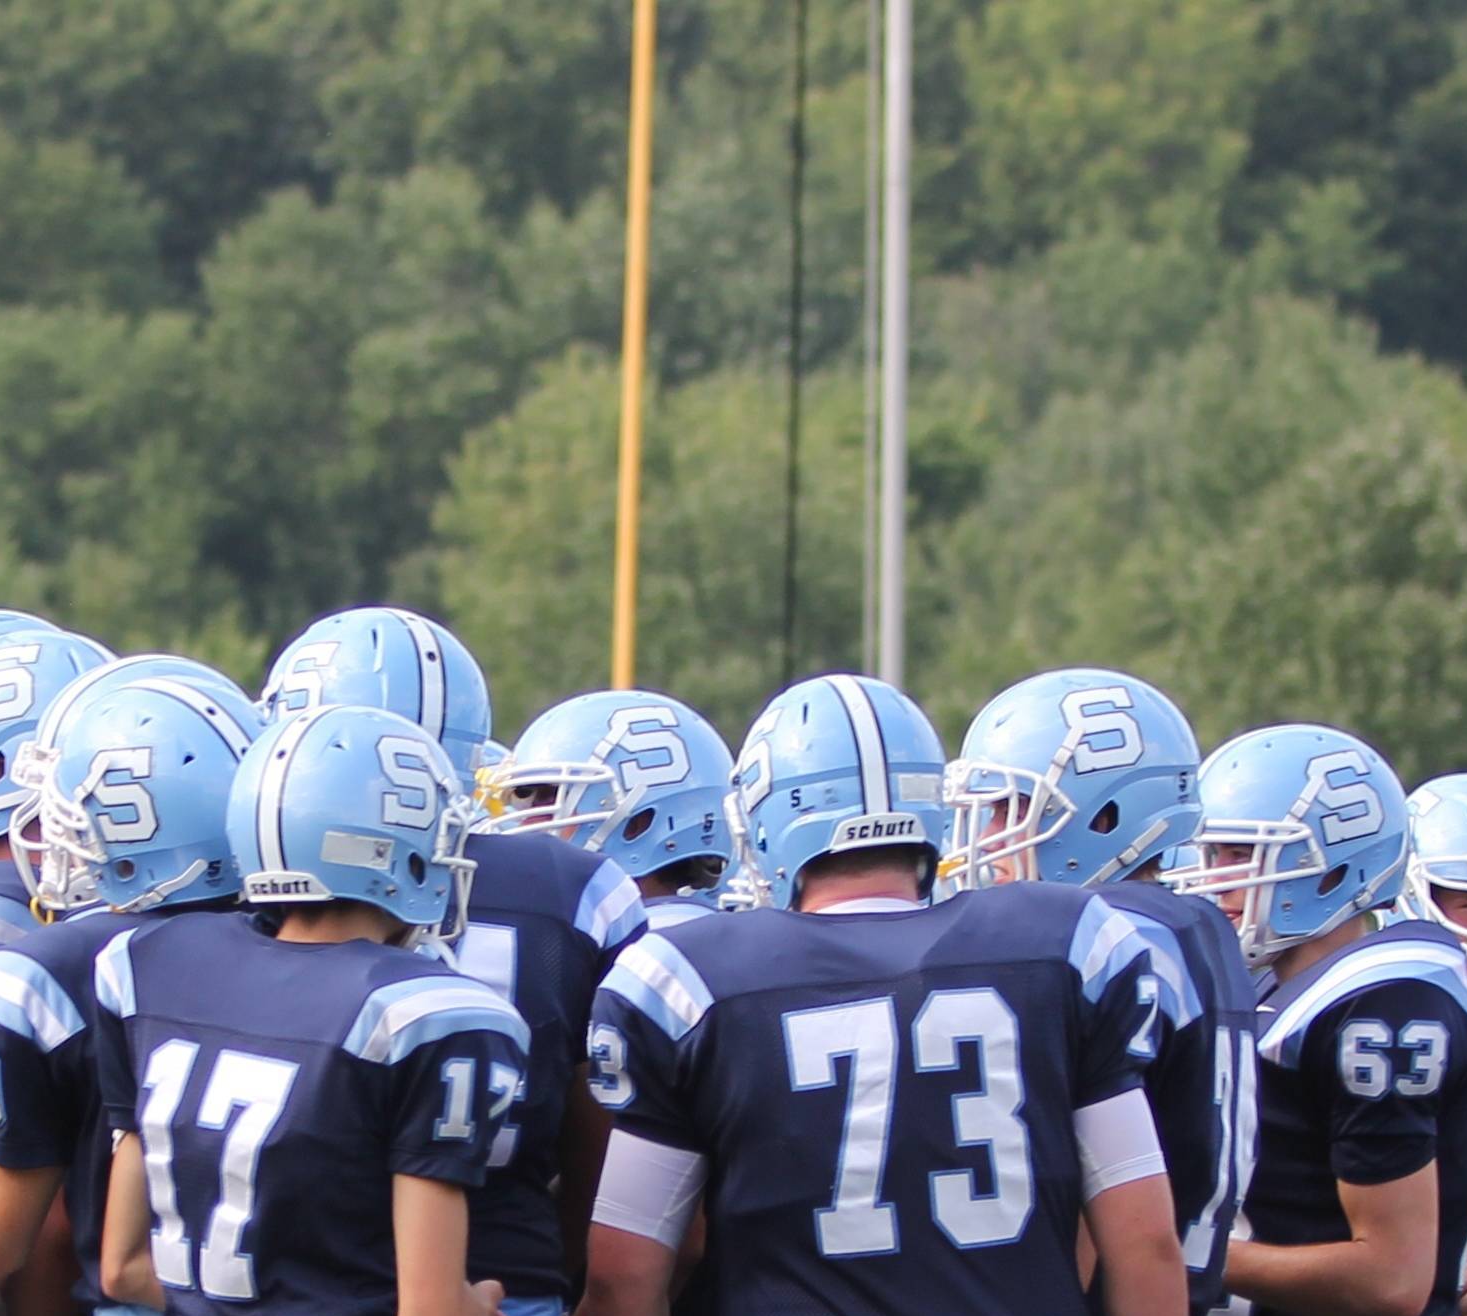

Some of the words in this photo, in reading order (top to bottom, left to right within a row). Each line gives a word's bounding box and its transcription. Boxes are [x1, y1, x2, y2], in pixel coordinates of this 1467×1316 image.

[278, 640, 342, 714] S
[607, 706, 693, 788] S
[1059, 685, 1145, 776] S
[88, 746, 159, 843] S
[376, 734, 439, 832] S
[1305, 749, 1385, 847] S
[844, 818, 917, 842] schutt
[587, 1022, 635, 1110] 3
[1337, 1018, 1451, 1100] 63
[781, 987, 1033, 1259] 73
[142, 1038, 301, 1301] 17
